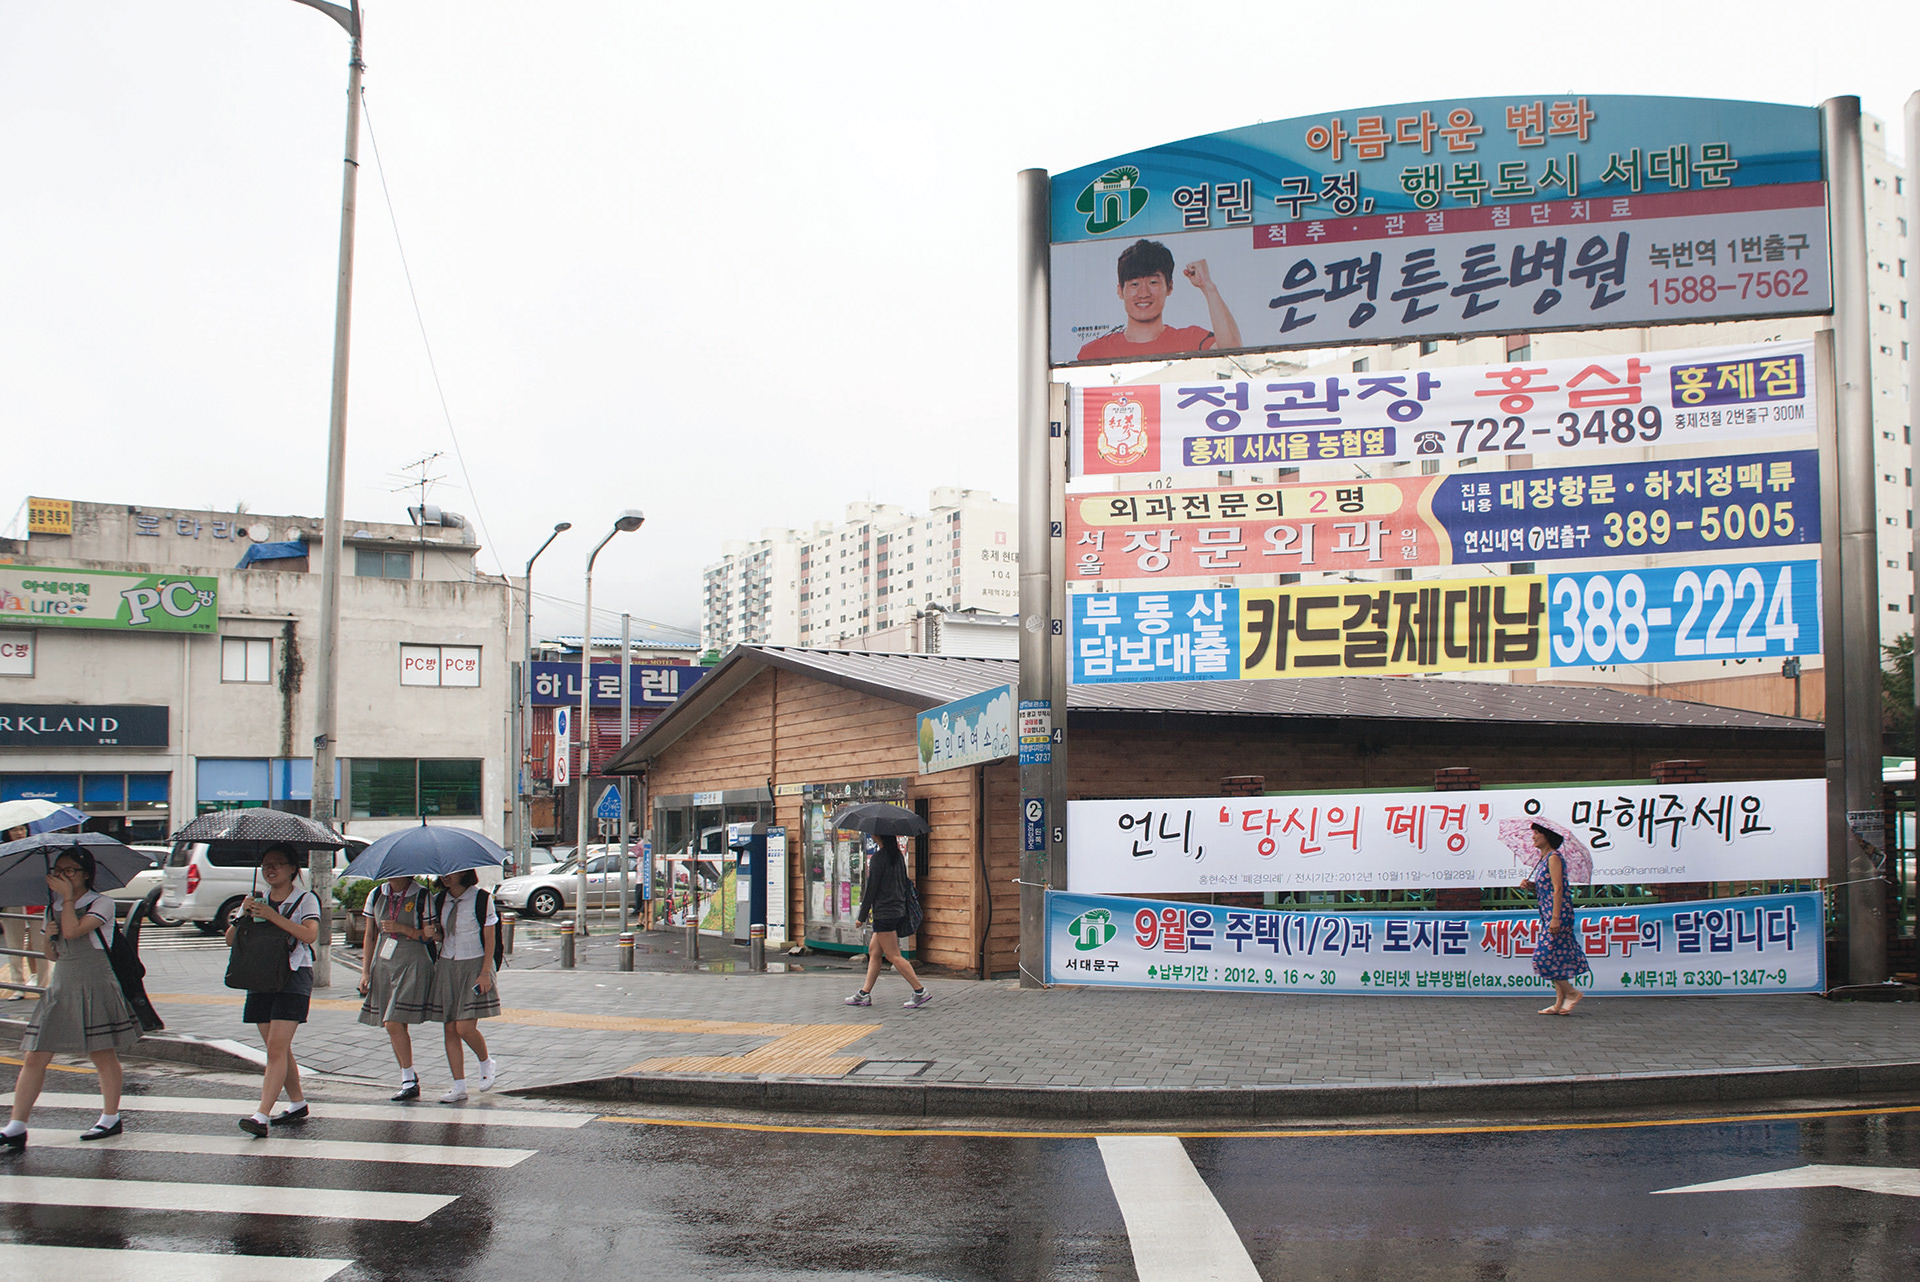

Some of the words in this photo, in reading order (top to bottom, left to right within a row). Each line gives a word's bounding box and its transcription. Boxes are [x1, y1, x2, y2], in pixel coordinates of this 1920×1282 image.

[1305, 108, 1483, 162] 아름다운
[1506, 97, 1595, 147] 변화
[1172, 178, 1252, 229] 열린
[1274, 170, 1374, 218] 구정,
[1400, 152, 1578, 209] 행복도시
[1601, 142, 1738, 192] 서대문
[1649, 238, 1717, 269] 녹번역
[1728, 233, 1810, 264] 1번출구
[1648, 268, 1809, 306] 1588-7562
[1177, 372, 1441, 432] 정관장
[1474, 358, 1652, 415] 홍삼
[1674, 358, 1798, 404] 홍제점
[1675, 411, 1723, 429] 홍제전철
[1726, 408, 1769, 425] 2번출구
[1773, 405, 1804, 421] 300M
[1053, 424, 1060, 437] 1
[1450, 406, 1662, 454] 722-3489
[1119, 444, 1126, 456] 6
[1190, 437, 1234, 465] 홍제
[1242, 433, 1311, 462] 서서울
[1317, 430, 1385, 459] 농협옆
[1461, 482, 1492, 498] 진료
[1110, 489, 1284, 522] 외과전문의
[1462, 498, 1492, 513] 내용
[136, 516, 236, 542] 로타리
[1053, 523, 1061, 537] 2
[1603, 501, 1795, 548] 389-5005
[1122, 520, 1391, 573] 장문외과
[1464, 528, 1525, 554] 연신내역
[981, 549, 999, 562] 홍제
[992, 571, 1010, 579] 104
[120, 581, 216, 626] PC방
[1082, 592, 1228, 635] 부동산
[1553, 565, 1799, 664] 388-2224
[1053, 621, 1061, 635] 3
[1245, 583, 1545, 672] 카드결제대납
[405, 658, 437, 671] PC방
[446, 658, 476, 671] PC방
[1080, 631, 1231, 676] 담보대출
[1053, 729, 1062, 743] 4
[1020, 753, 1050, 762] 711-3737
[1029, 803, 1038, 817] 2
[1571, 794, 1772, 849] 말해주세요
[1054, 827, 1062, 842] 5
[1118, 810, 1203, 861] 언니,
[1488, 868, 1534, 880] 복합문화
[1134, 908, 1214, 953] 9월은
[1226, 912, 1371, 956] 주택(1/2)과
[1382, 919, 1470, 956] 토지분
[1481, 919, 1542, 958] 재산
[1581, 915, 1663, 957] 납부의
[1673, 906, 1798, 954] 달입니다
[1066, 958, 1120, 973] 서대문구
[1159, 963, 1209, 981] 납부기간
[1283, 968, 1298, 984] 16
[1320, 969, 1336, 985] 30
[1373, 969, 1410, 987] 인터넷
[1633, 970, 1677, 988] 세무1과
